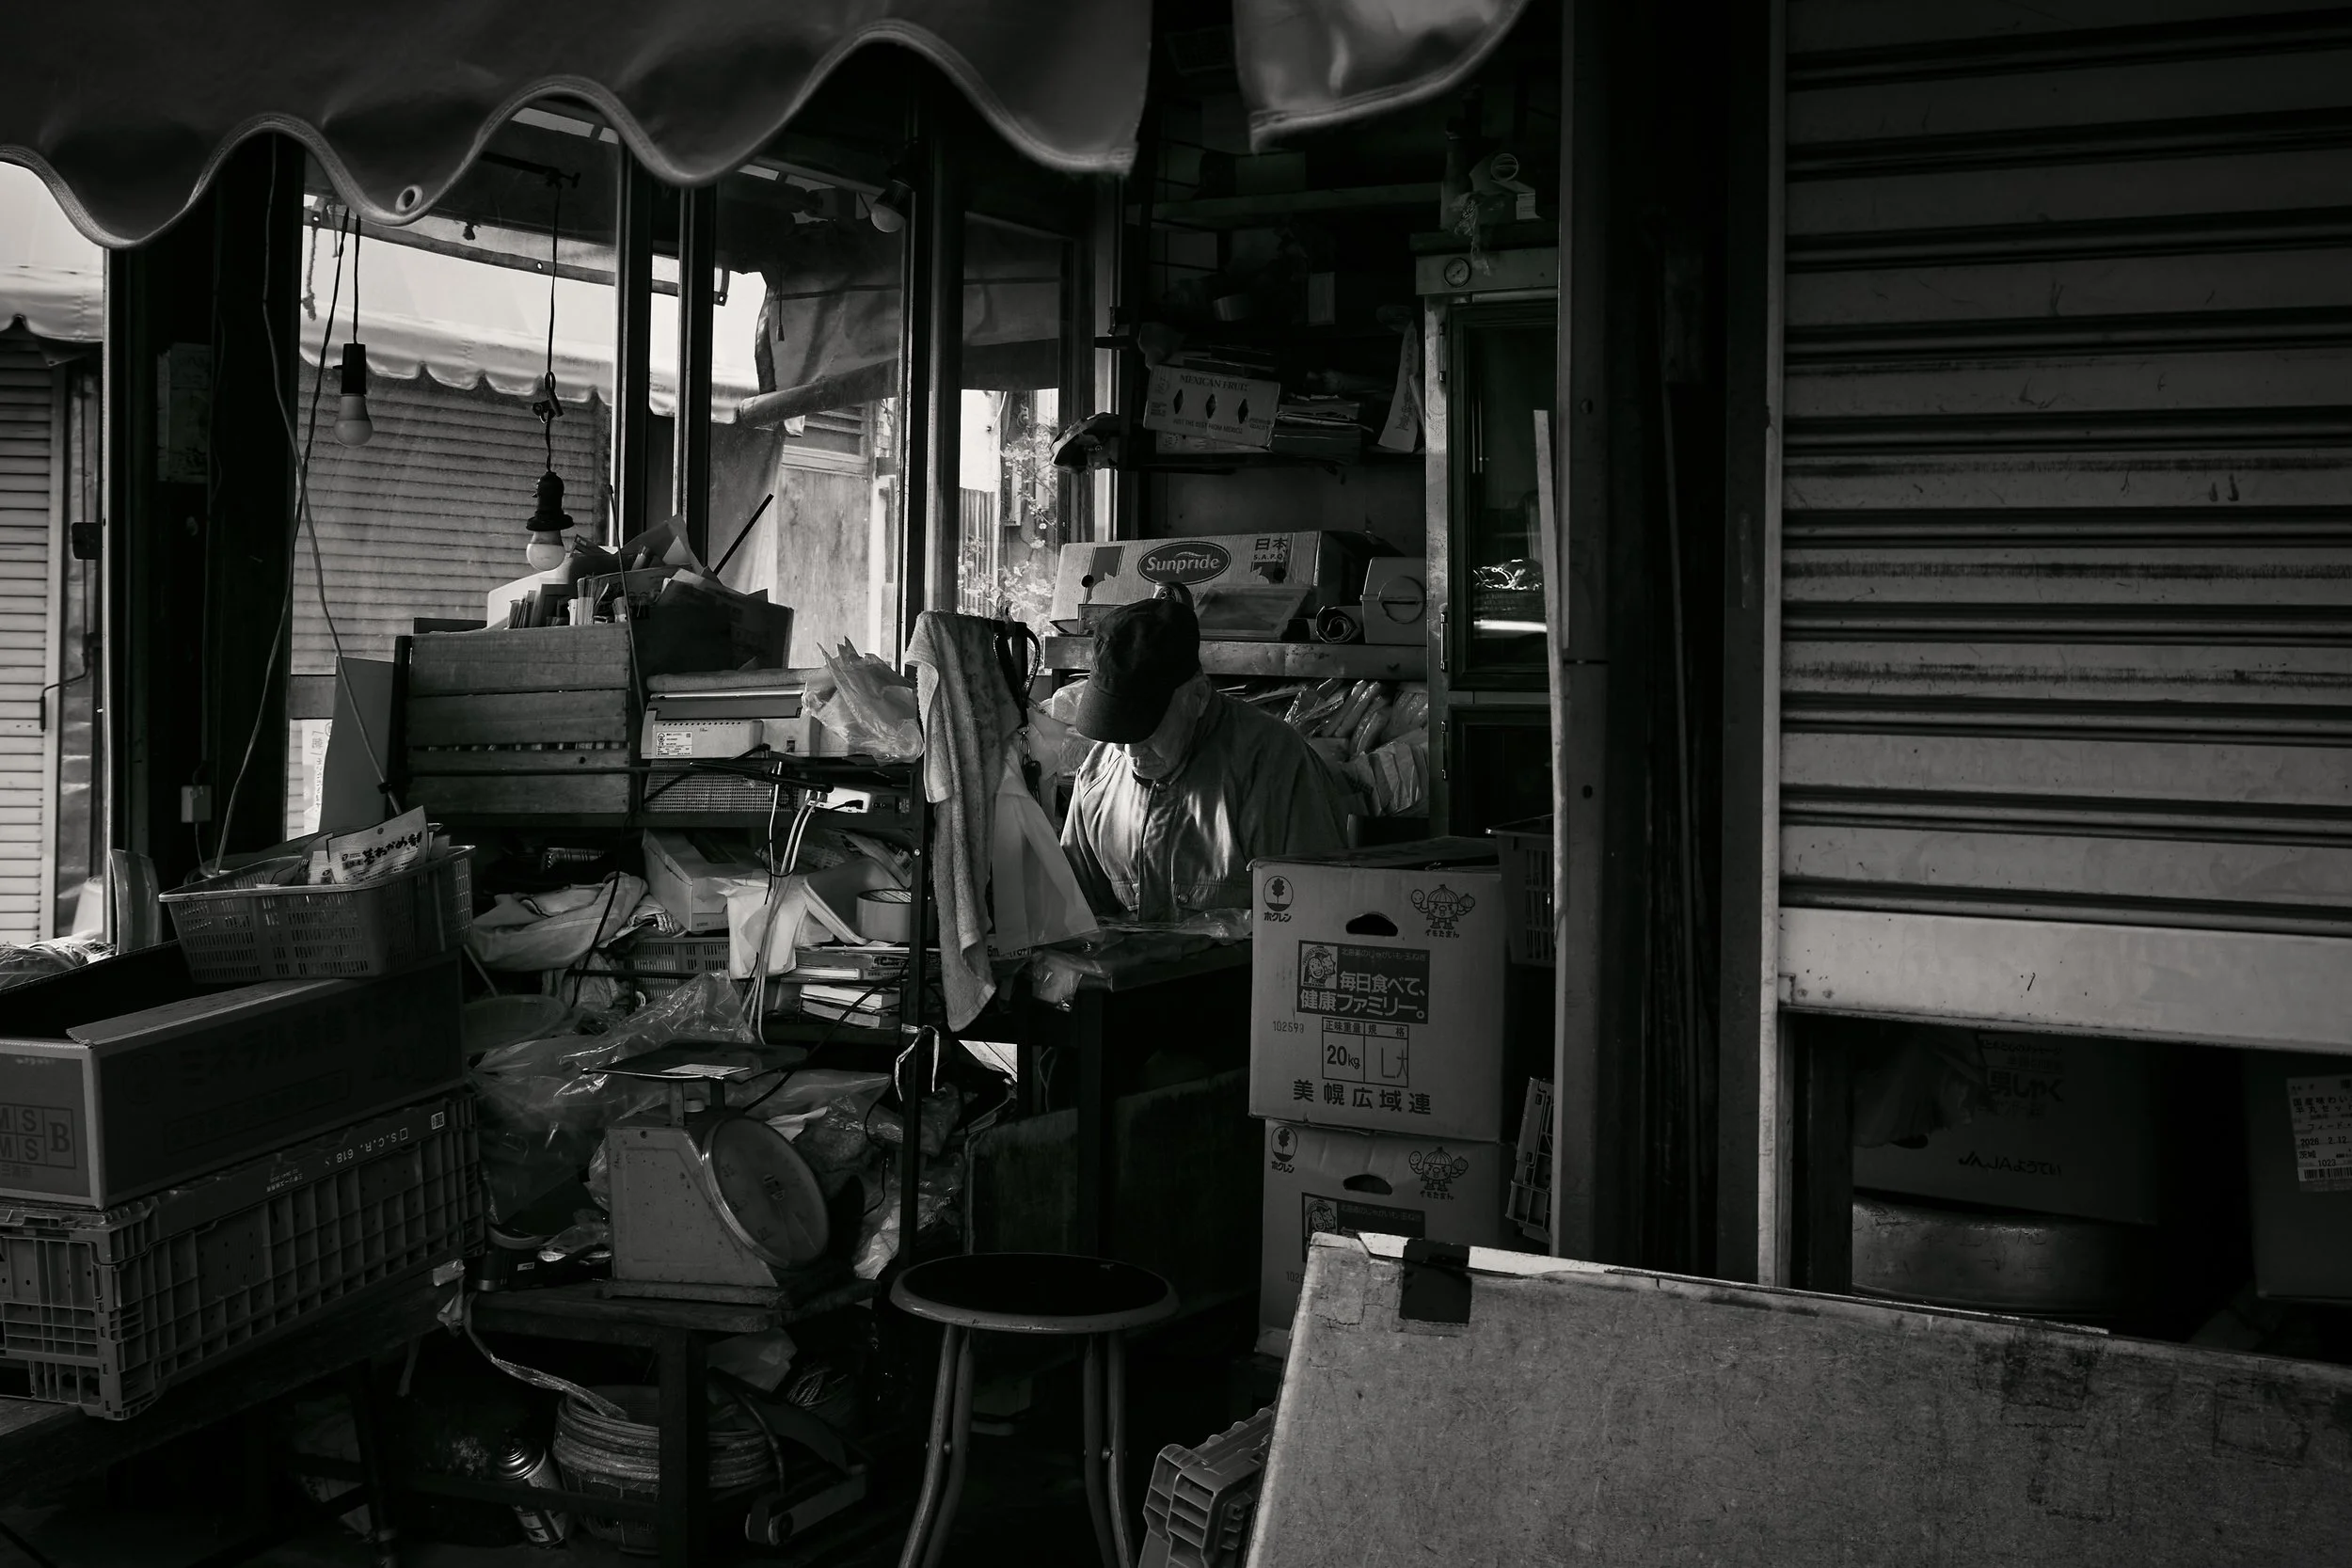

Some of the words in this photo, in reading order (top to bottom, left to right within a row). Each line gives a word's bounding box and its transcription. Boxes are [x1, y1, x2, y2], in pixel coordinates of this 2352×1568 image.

[1255, 537, 1288, 551] 日本
[1146, 553, 1221, 576] Sunpride
[1263, 911, 1292, 923] ホクレン
[1340, 970, 1425, 997] 毎日食べて、
[1299, 989, 1426, 1020] 健康ファミリー。
[1325, 1019, 1361, 1034] 正味重量
[1293, 1079, 1431, 1116] 美幌広域連
[49, 1121, 71, 1152] B
[336, 1148, 355, 1164] 618
